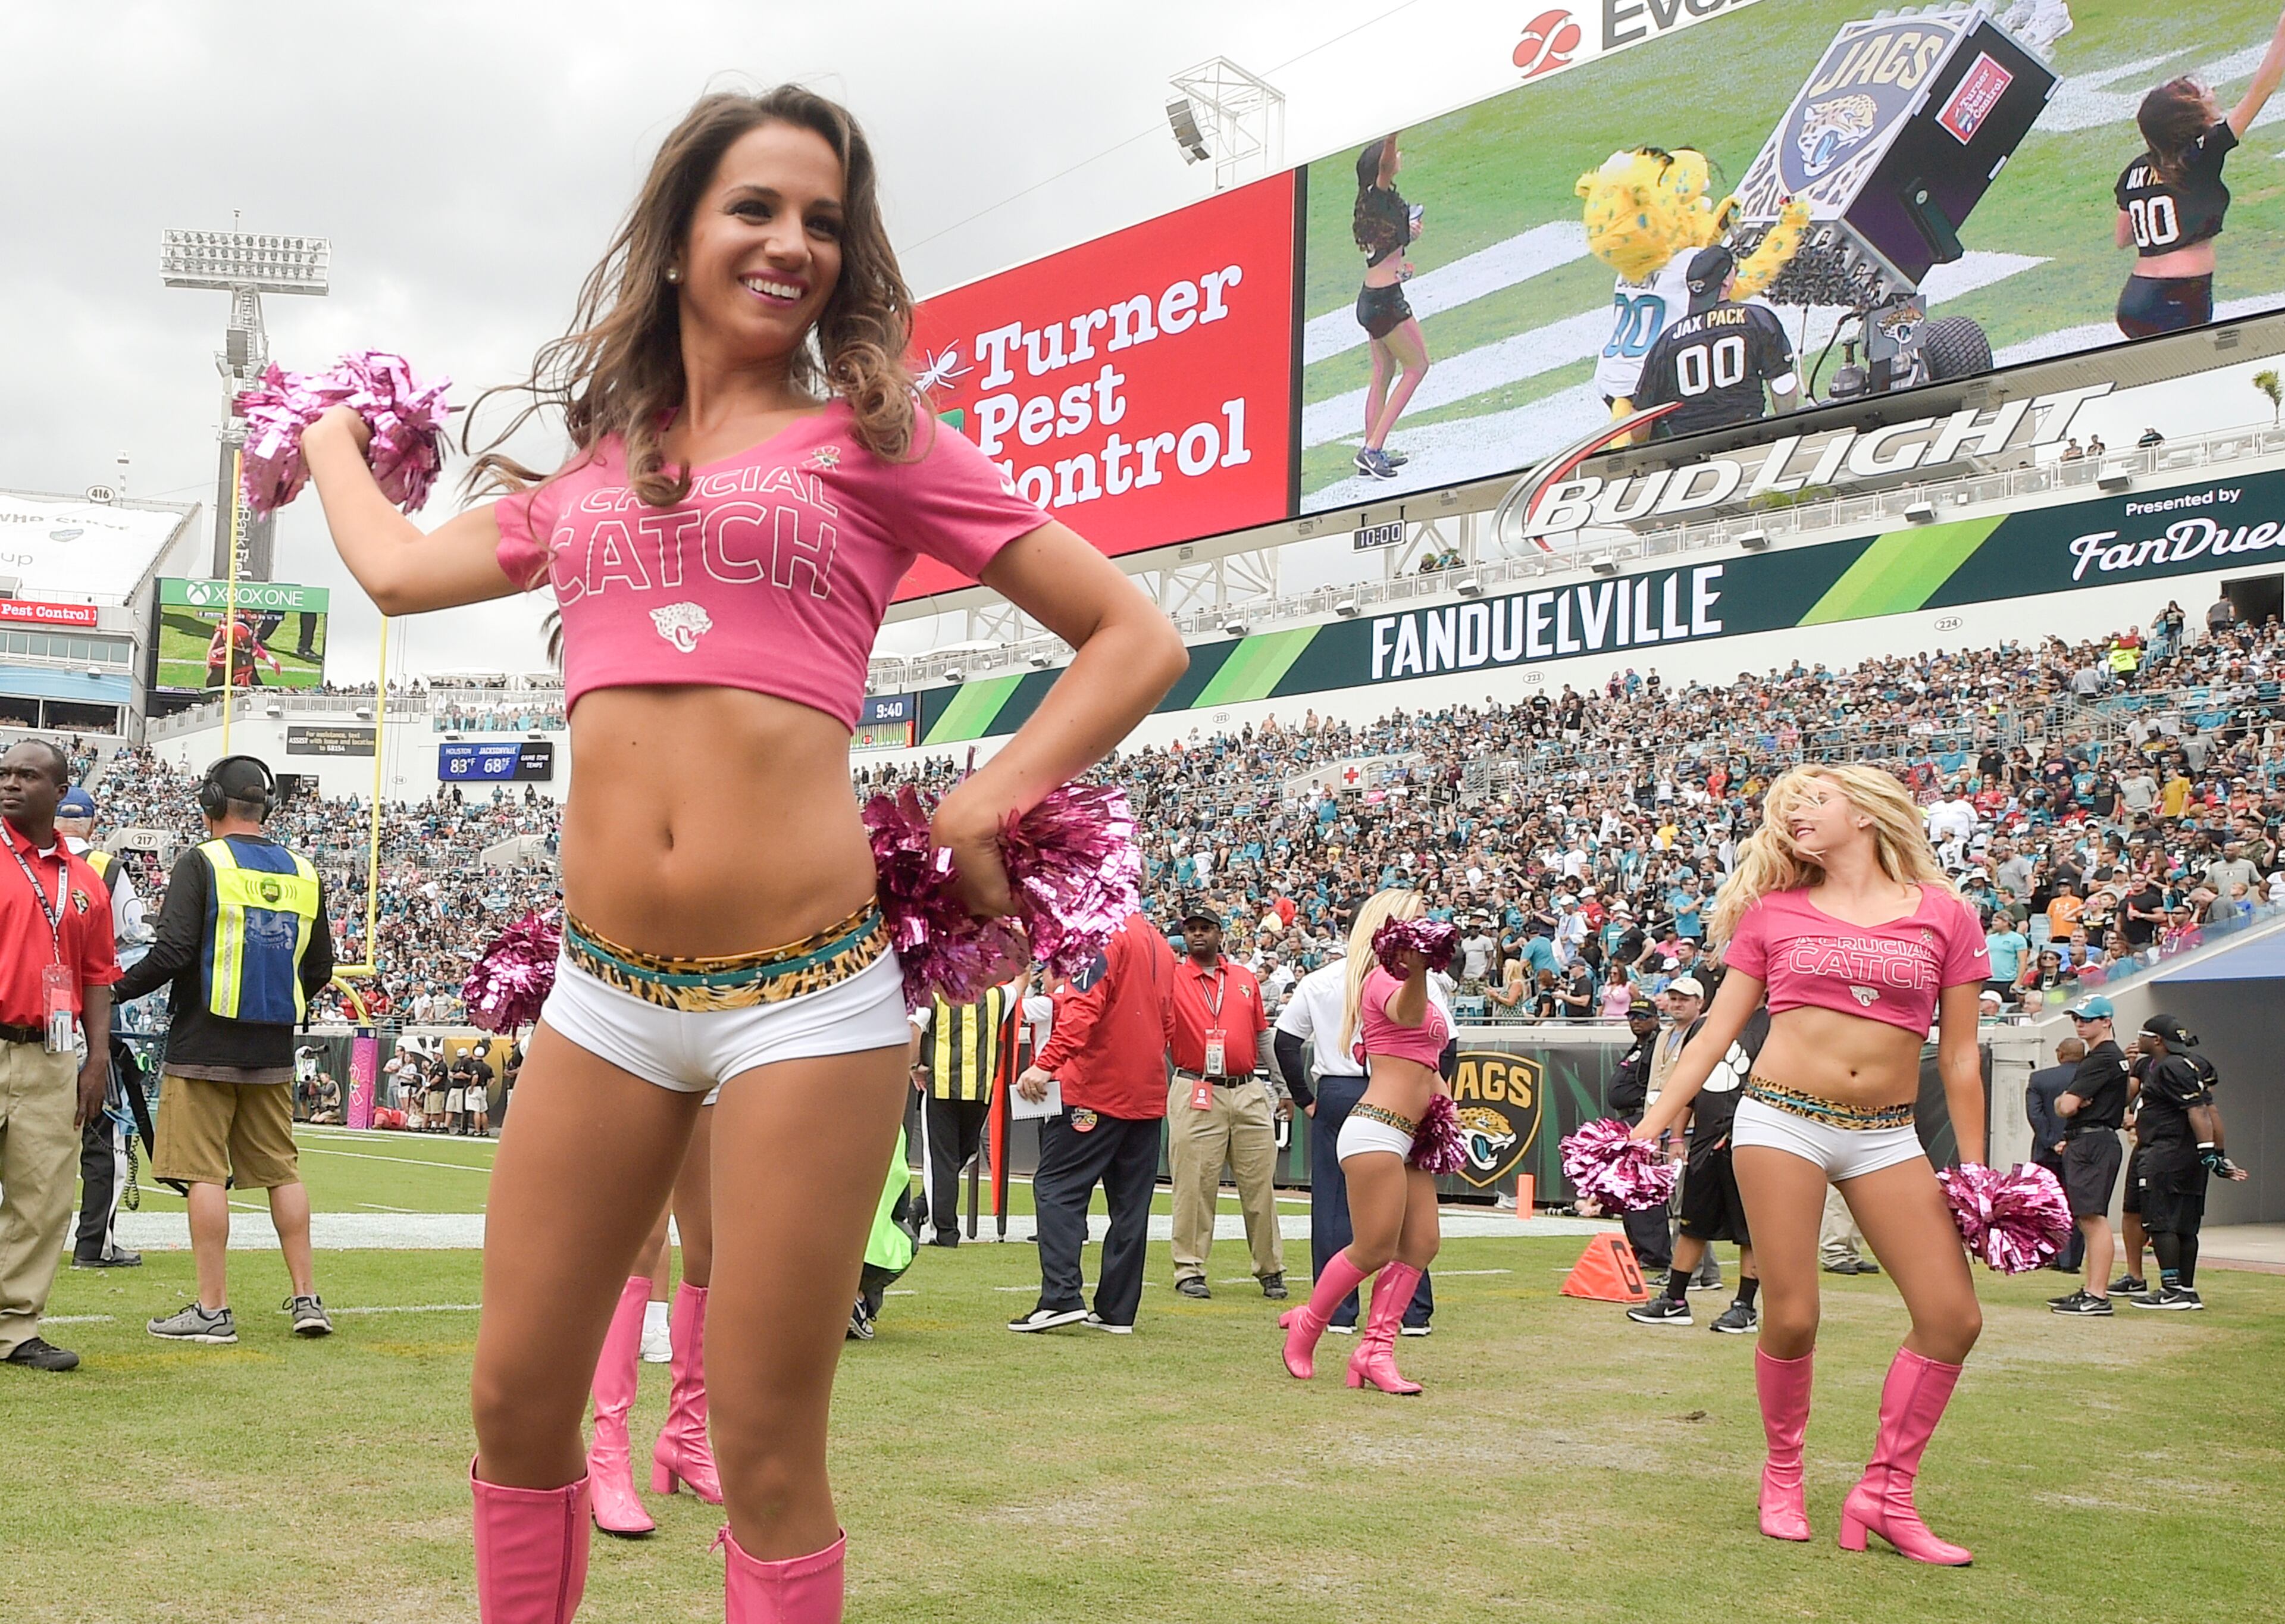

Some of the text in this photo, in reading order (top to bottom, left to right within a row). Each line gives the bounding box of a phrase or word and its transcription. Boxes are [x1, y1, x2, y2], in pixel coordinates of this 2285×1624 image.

[1808, 32, 1944, 99] JAGS
[1959, 68, 1990, 109] Turner
[1967, 89, 1987, 115] Pest
[1973, 77, 2005, 119] Control
[2129, 195, 2180, 248] 00
[974, 264, 1243, 392] Turner
[1672, 308, 1746, 340] JAX PACK
[1676, 334, 1745, 398] 00
[973, 364, 1127, 455] Pest
[995, 397, 1251, 511] ontrol
[1522, 381, 2116, 539] BUD LIGHT
[91, 489, 110, 499] 416
[2126, 488, 2241, 517] Presented by
[1360, 524, 1401, 547] 10:00
[548, 501, 837, 607] CATCH
[1, 603, 33, 617] Pest
[36, 606, 90, 621] Control
[213, 586, 305, 606] XBOX ONE
[1370, 564, 1724, 680] FANDUELVILLE
[1939, 619, 1958, 628] 224
[876, 702, 903, 719] 9:40
[478, 746, 517, 755] JACKSONVILLE
[136, 836, 152, 845] 217
[1946, 850, 1957, 865] 5
[2174, 850, 2186, 863] 5
[1453, 915, 1471, 930] 56
[1789, 946, 1936, 990] CATCH
[1448, 1061, 1532, 1109] AGS
[1610, 1240, 1644, 1294] G
